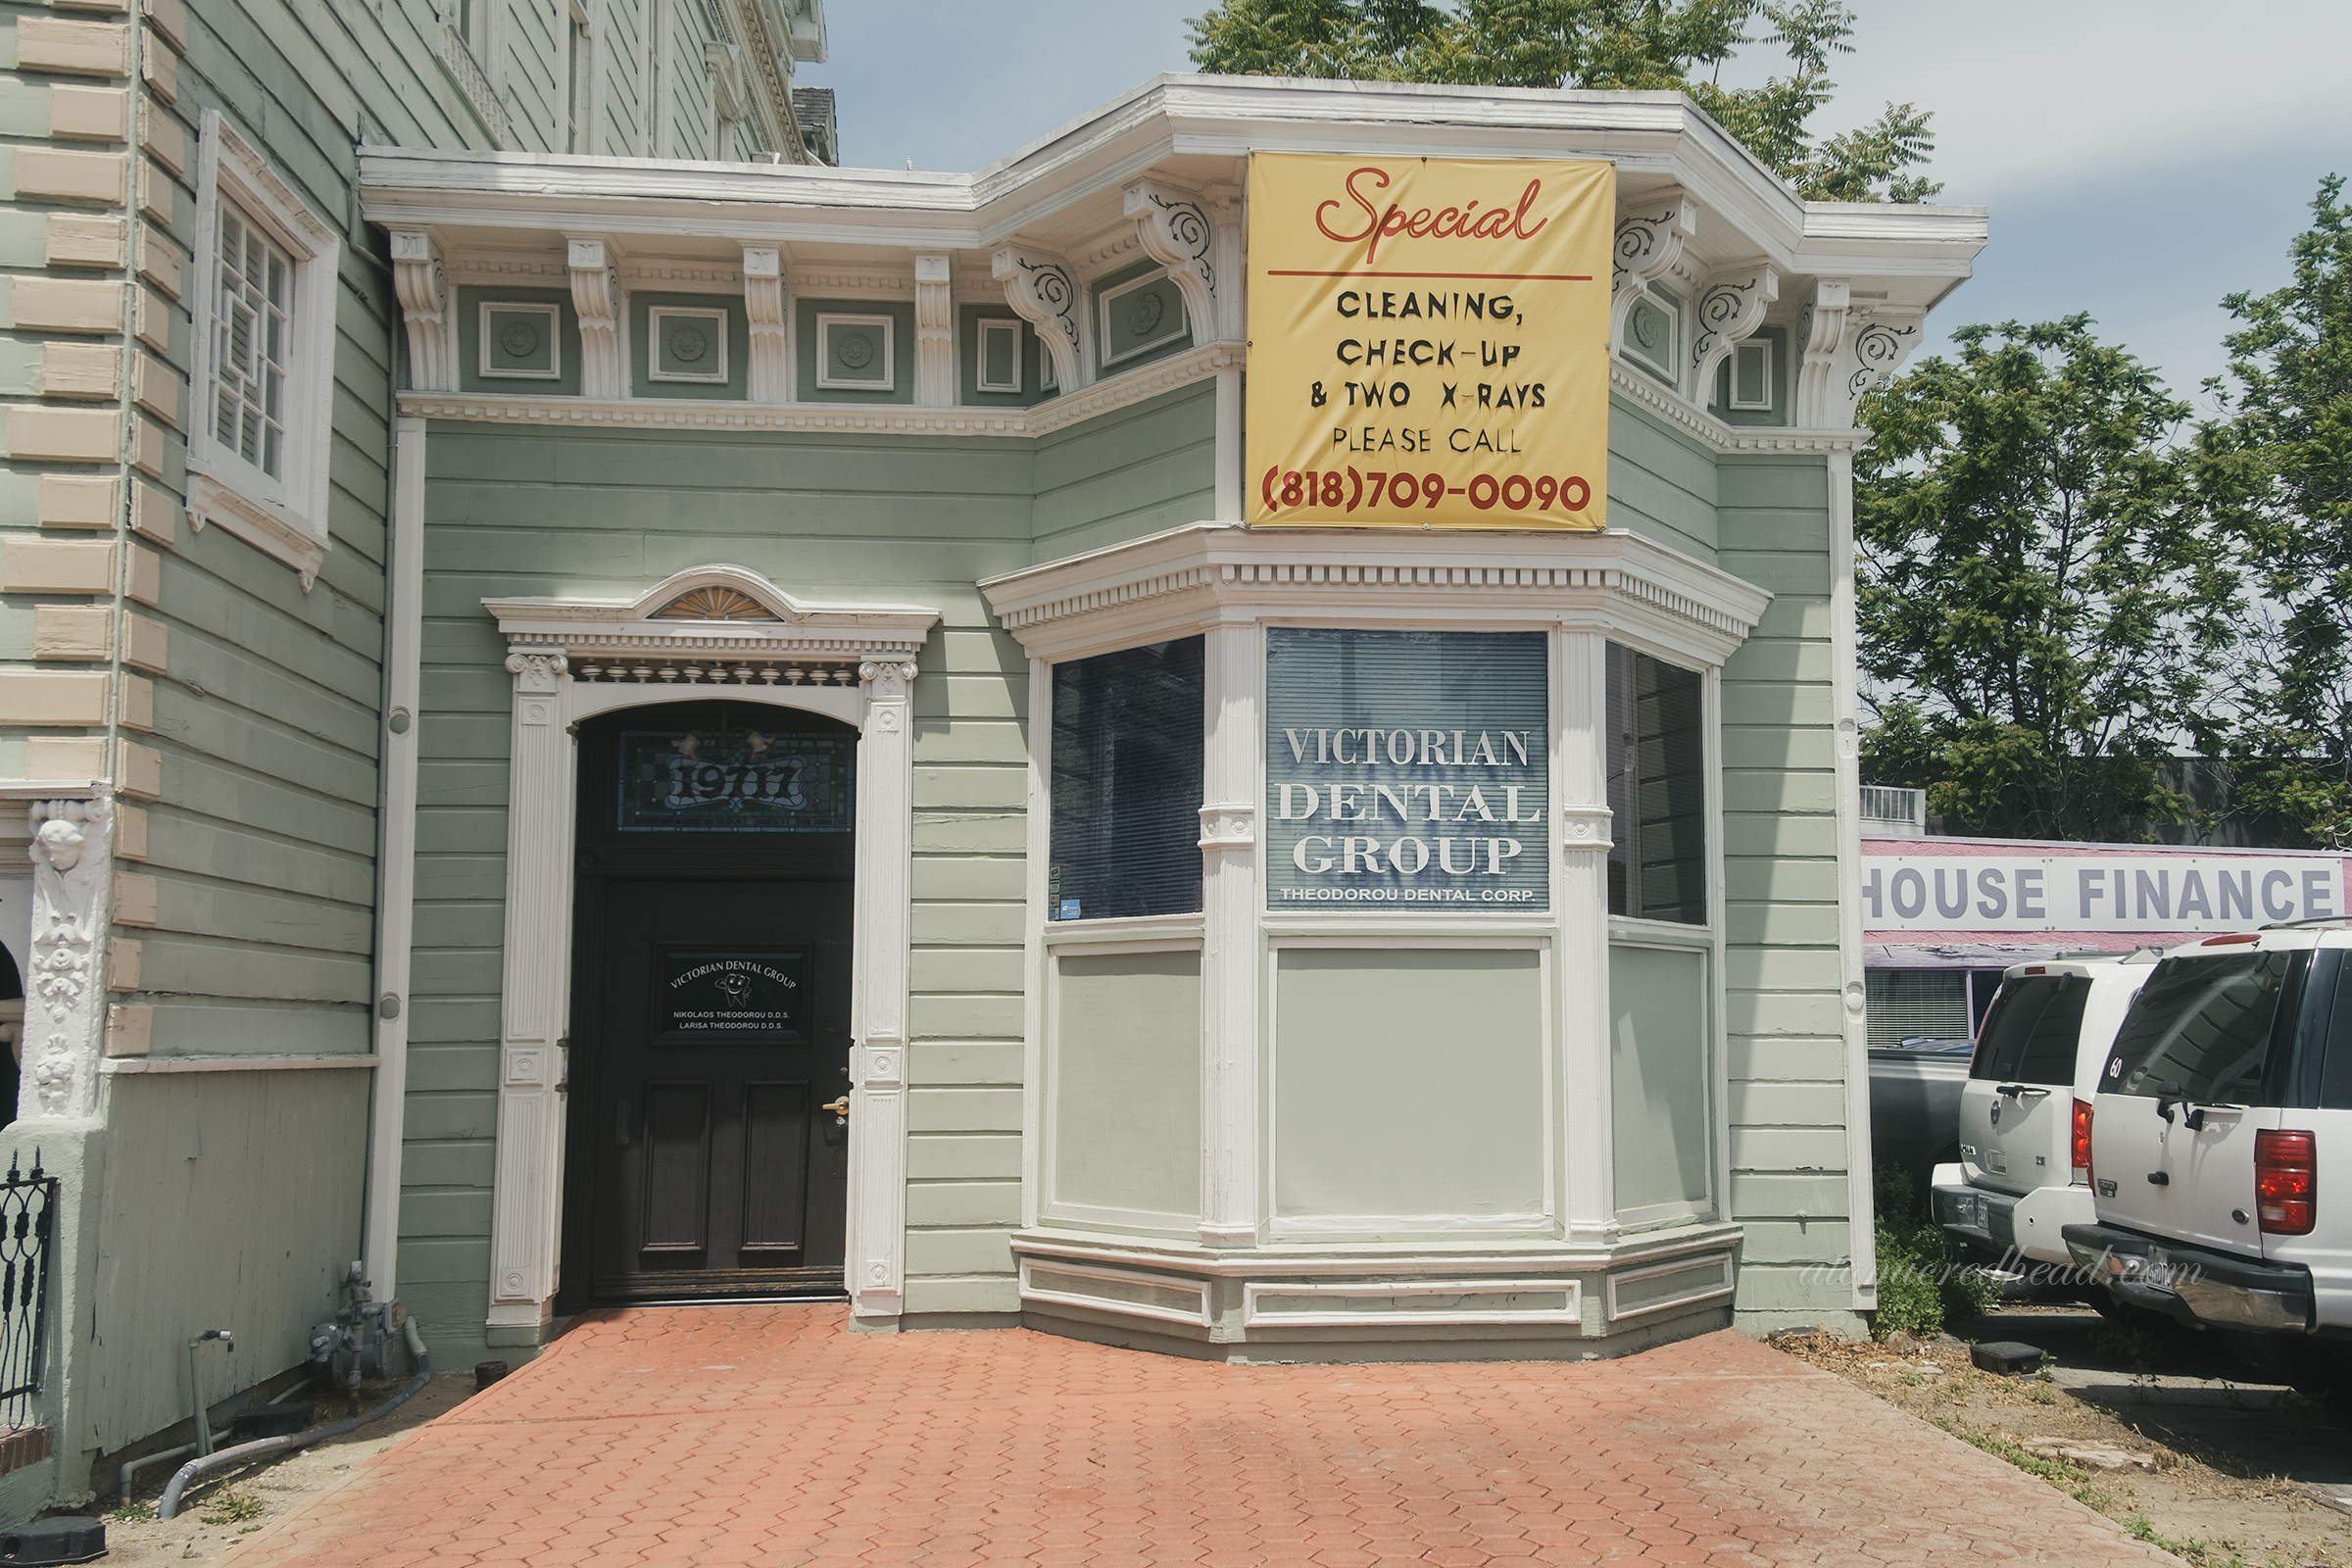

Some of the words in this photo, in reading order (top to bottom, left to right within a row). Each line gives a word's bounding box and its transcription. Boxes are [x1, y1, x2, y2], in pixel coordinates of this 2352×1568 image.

[1315, 167, 1547, 265] Special
[1336, 291, 1523, 325] CLEANING,
[1336, 338, 1521, 368] CHECK-UP
[1310, 380, 1327, 408] &
[1345, 381, 1410, 408] TWO
[1440, 381, 1546, 410] X-RAYS
[1332, 426, 1431, 453] PLEASE
[1448, 427, 1522, 454] CALL
[1261, 465, 1592, 513] (818)709-0090
[1283, 728, 1530, 766] VICTORIAN
[1274, 784, 1541, 822] DENTAL
[1294, 836, 1522, 874] GROUP
[1280, 888, 1398, 901] THEODOROU
[1404, 889, 1476, 902] DENTAL
[1481, 889, 1536, 902] CORP.
[2079, 868, 2332, 920] FINANCE
[670, 961, 724, 989] VICTORIAN
[725, 960, 761, 974] DENTAL
[763, 966, 797, 990] GROUP
